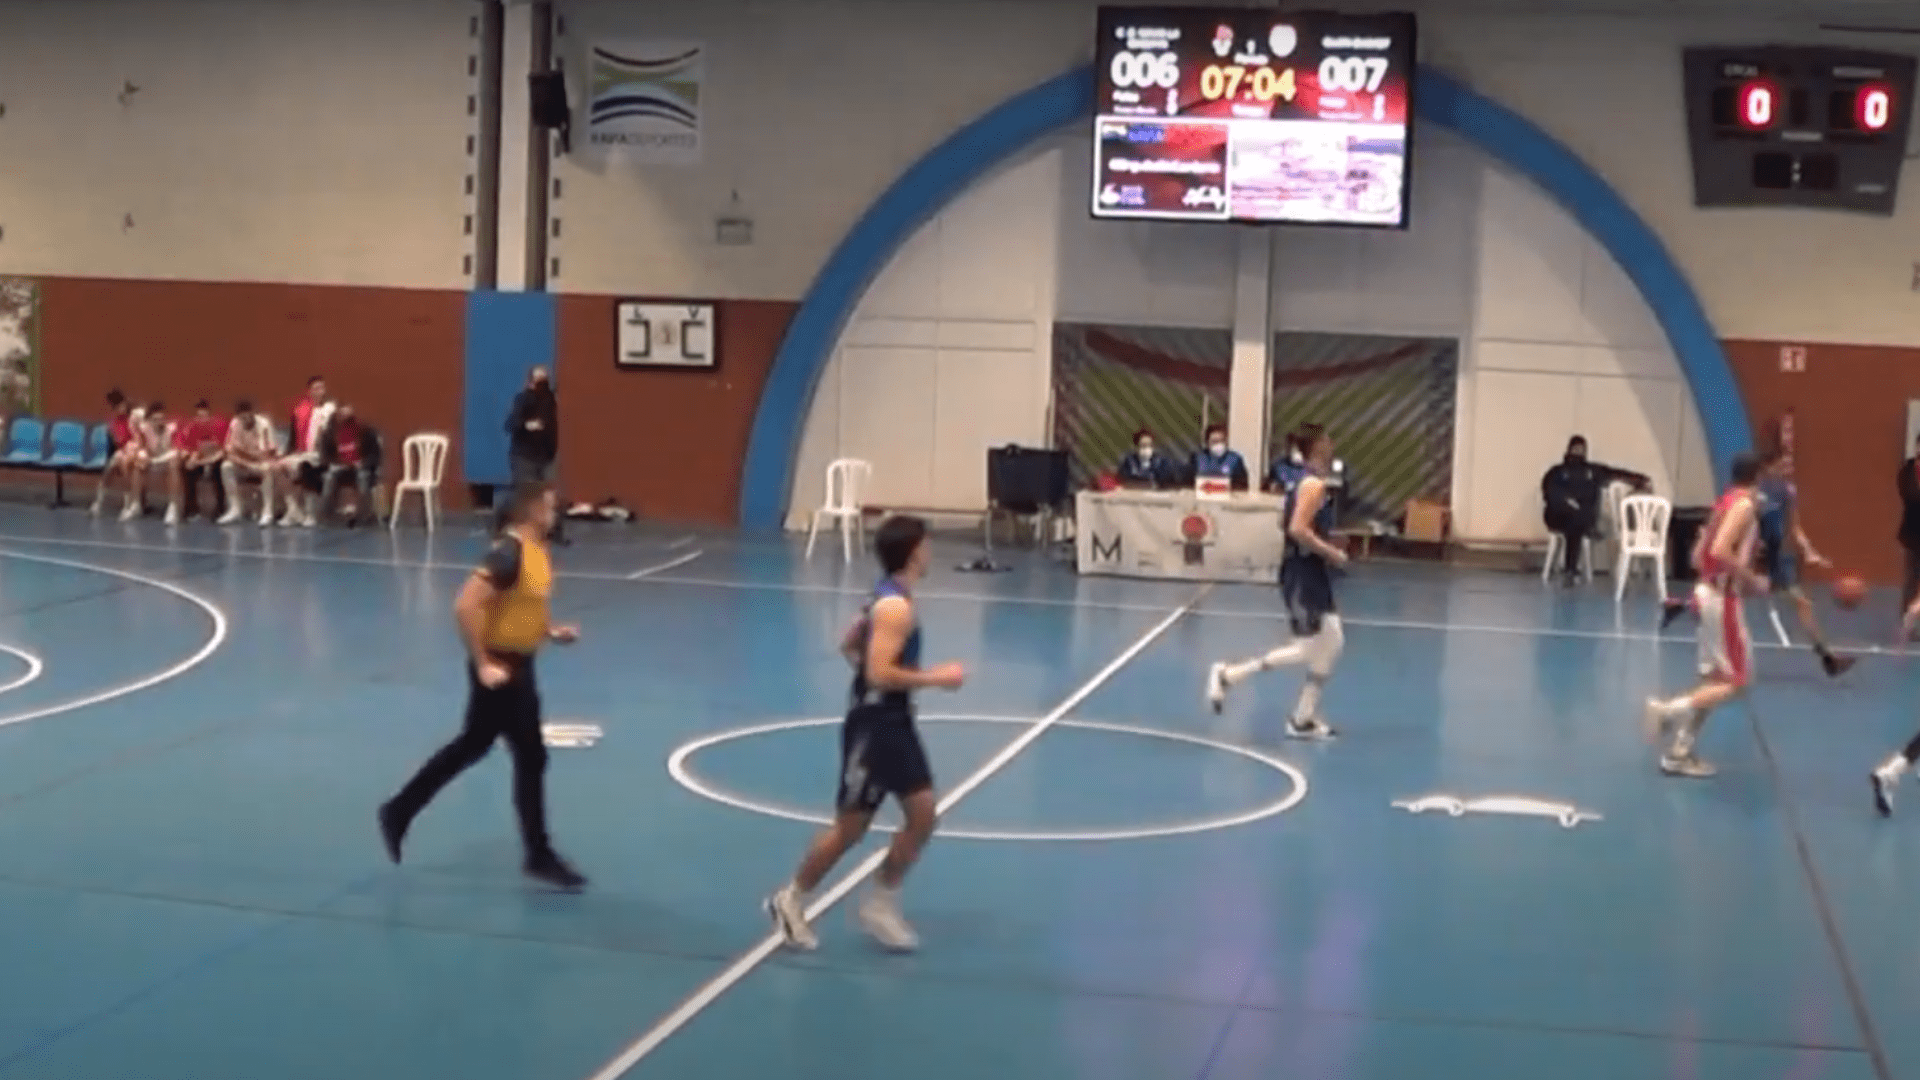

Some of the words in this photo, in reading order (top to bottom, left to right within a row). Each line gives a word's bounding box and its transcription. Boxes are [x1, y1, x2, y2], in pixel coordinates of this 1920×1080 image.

[1110, 51, 1180, 88] 006
[1200, 65, 1297, 102] 07:04
[1318, 56, 1389, 92] 007
[1748, 88, 1771, 124] 0
[1864, 91, 1889, 128] 0
[1091, 532, 1122, 562] M
